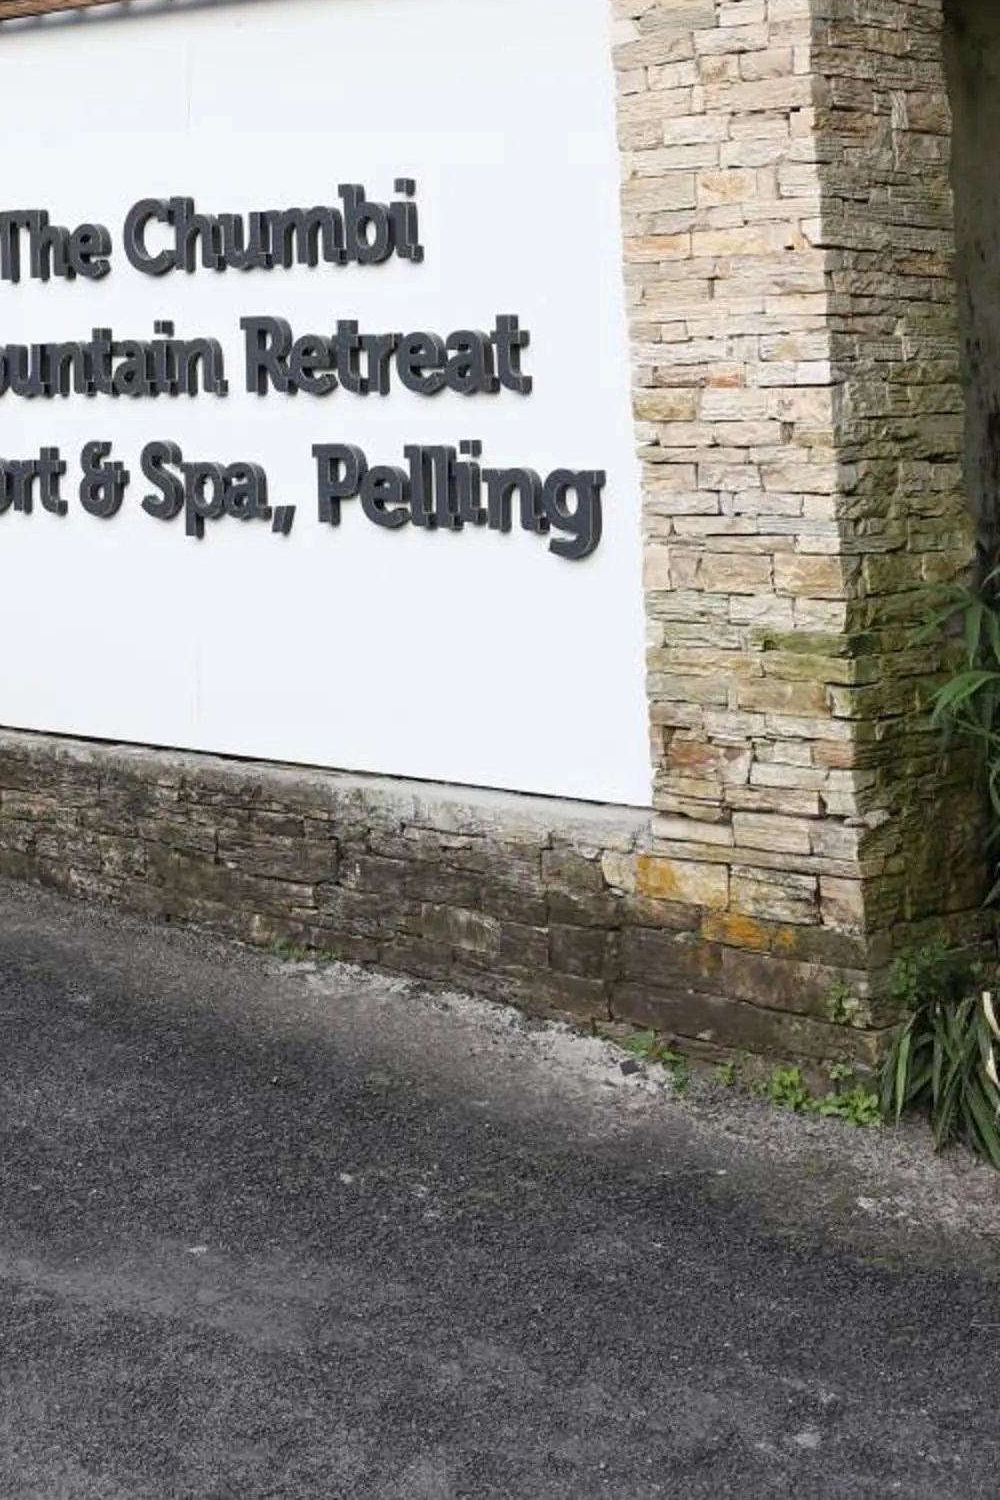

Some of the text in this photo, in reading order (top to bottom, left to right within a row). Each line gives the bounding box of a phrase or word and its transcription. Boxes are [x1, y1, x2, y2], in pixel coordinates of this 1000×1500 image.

[123, 178, 424, 278] Chumbi
[240, 315, 533, 398] Retreat
[79, 441, 130, 519] &
[140, 441, 296, 540] Spa,
[311, 439, 606, 562] Pelling
